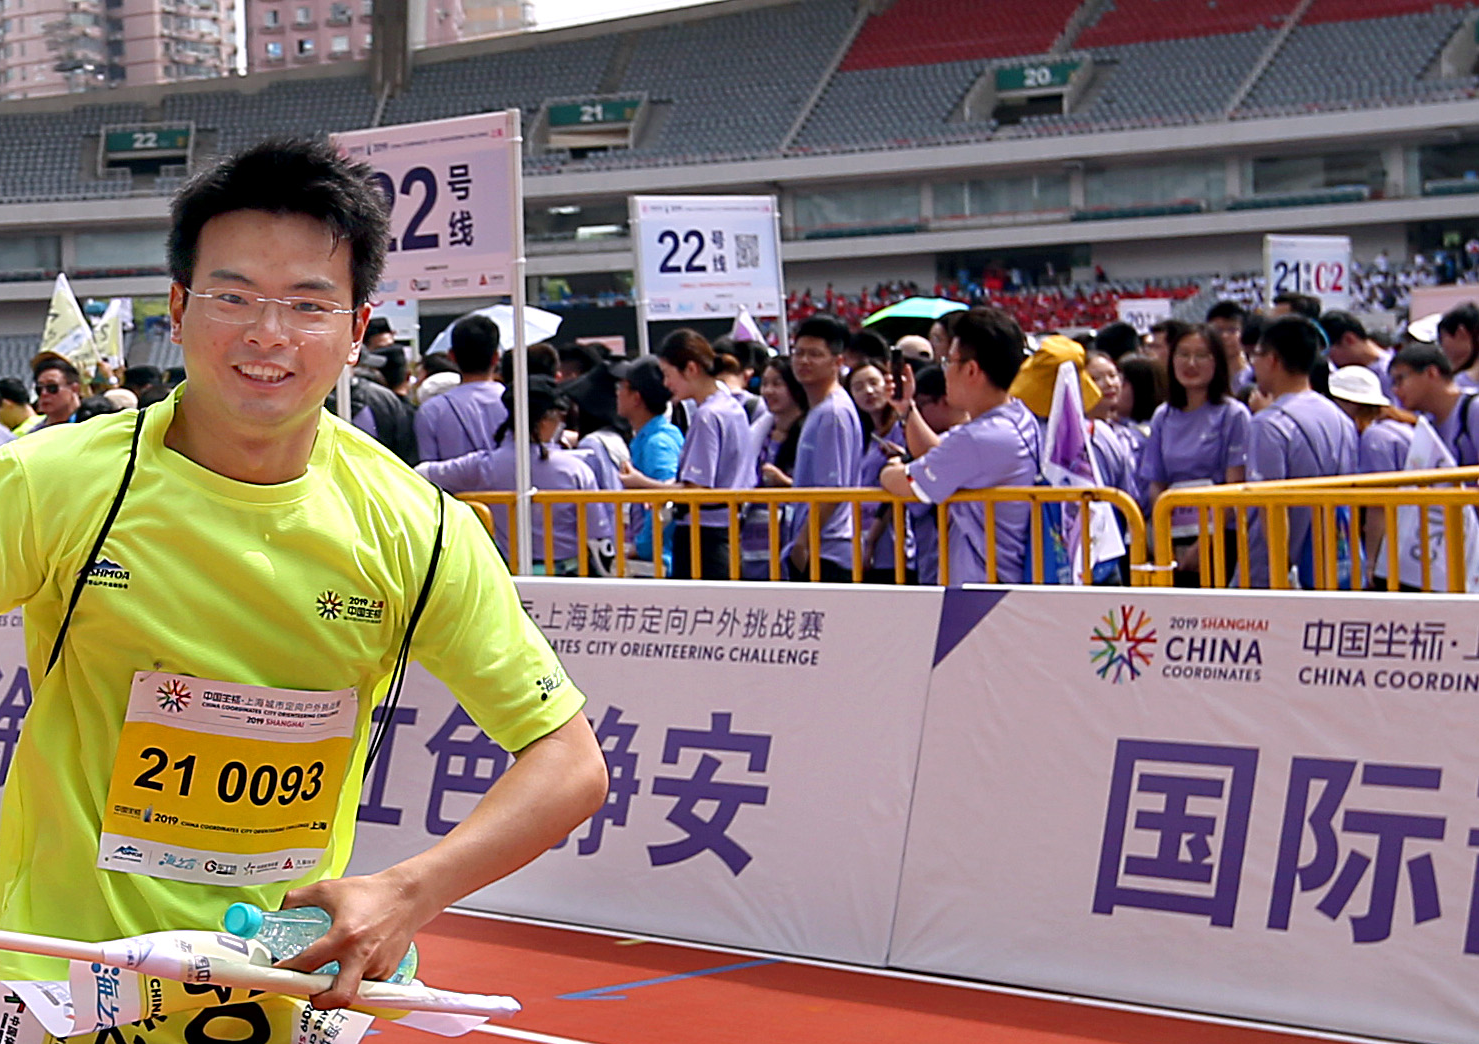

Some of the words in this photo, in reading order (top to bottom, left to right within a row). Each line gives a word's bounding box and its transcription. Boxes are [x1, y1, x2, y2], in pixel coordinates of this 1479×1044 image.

[1024, 66, 1052, 87] 20
[580, 104, 603, 121] 21
[132, 132, 158, 148] 22
[447, 164, 474, 247] 号线
[657, 230, 707, 274] 22
[1274, 261, 1302, 293] 21
[1315, 262, 1344, 292] C2
[349, 596, 368, 606] 2019
[1169, 616, 1200, 631] 2019
[1201, 618, 1269, 633] SHANGHAI
[586, 640, 619, 657] CITY
[619, 642, 725, 662] ORIENTEERING
[728, 646, 820, 667] CHALLENGE
[1165, 636, 1263, 665] CHINA
[1162, 666, 1262, 683] COORDINATES
[1298, 666, 1367, 688] CHINA
[246, 716, 264, 725] 2019
[265, 717, 305, 728] SHANGHAI
[133, 746, 197, 797] 21
[217, 760, 325, 806] 0093
[154, 812, 179, 826] 2019
[1092, 737, 1479, 957] 国际
[301, 1003, 315, 1033] 2019
